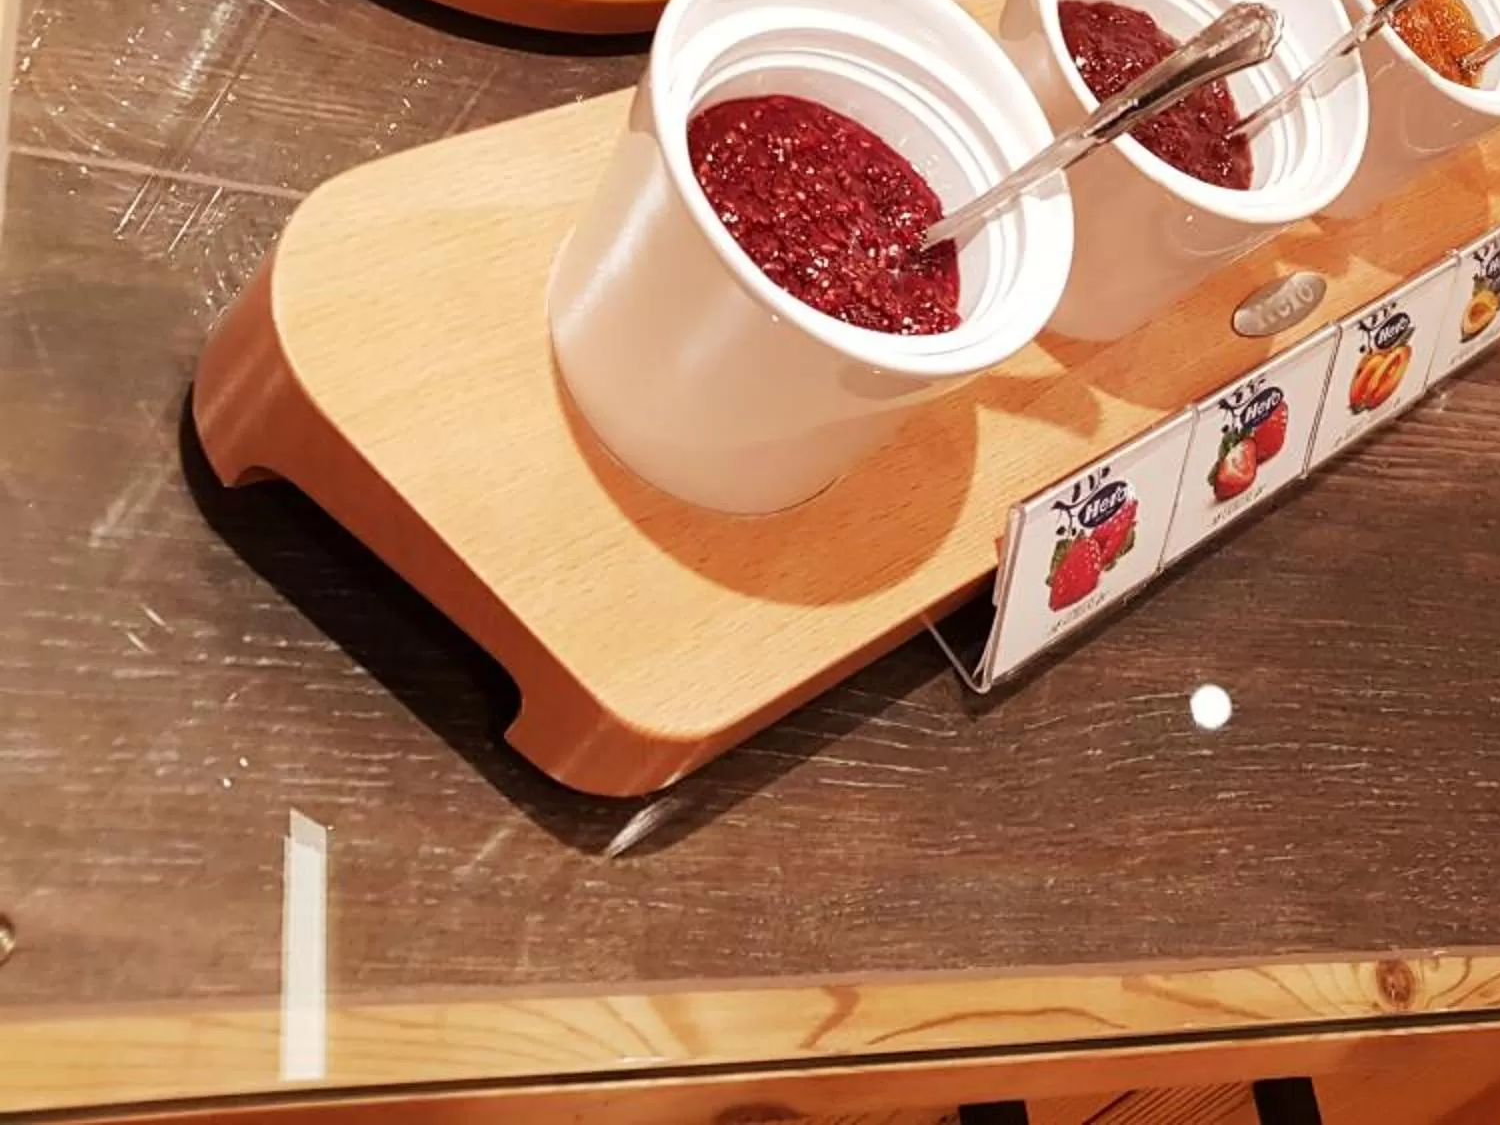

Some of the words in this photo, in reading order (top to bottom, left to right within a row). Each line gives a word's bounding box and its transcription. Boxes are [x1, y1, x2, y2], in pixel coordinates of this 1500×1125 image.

[1377, 317, 1409, 346] Hero
[1244, 390, 1282, 423] Hero
[1084, 485, 1127, 523] Hero
